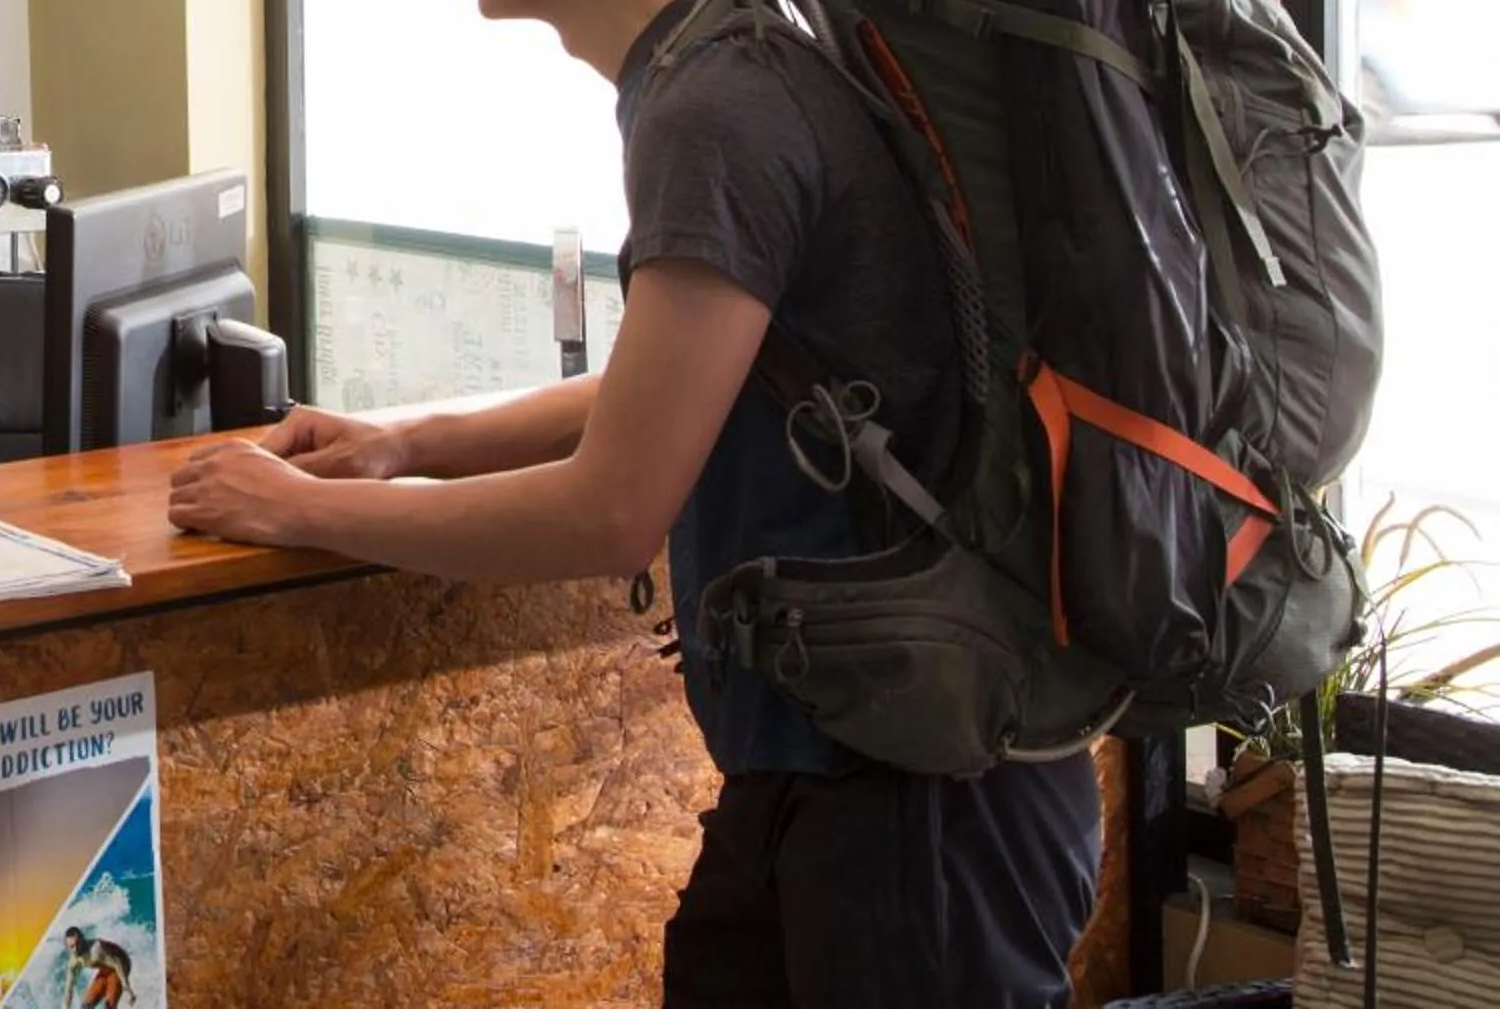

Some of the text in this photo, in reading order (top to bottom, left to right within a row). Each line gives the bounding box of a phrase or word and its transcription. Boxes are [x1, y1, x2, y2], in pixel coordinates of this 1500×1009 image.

[0, 716, 51, 745] WILL
[58, 704, 82, 732] BE
[90, 692, 144, 725] YOUR
